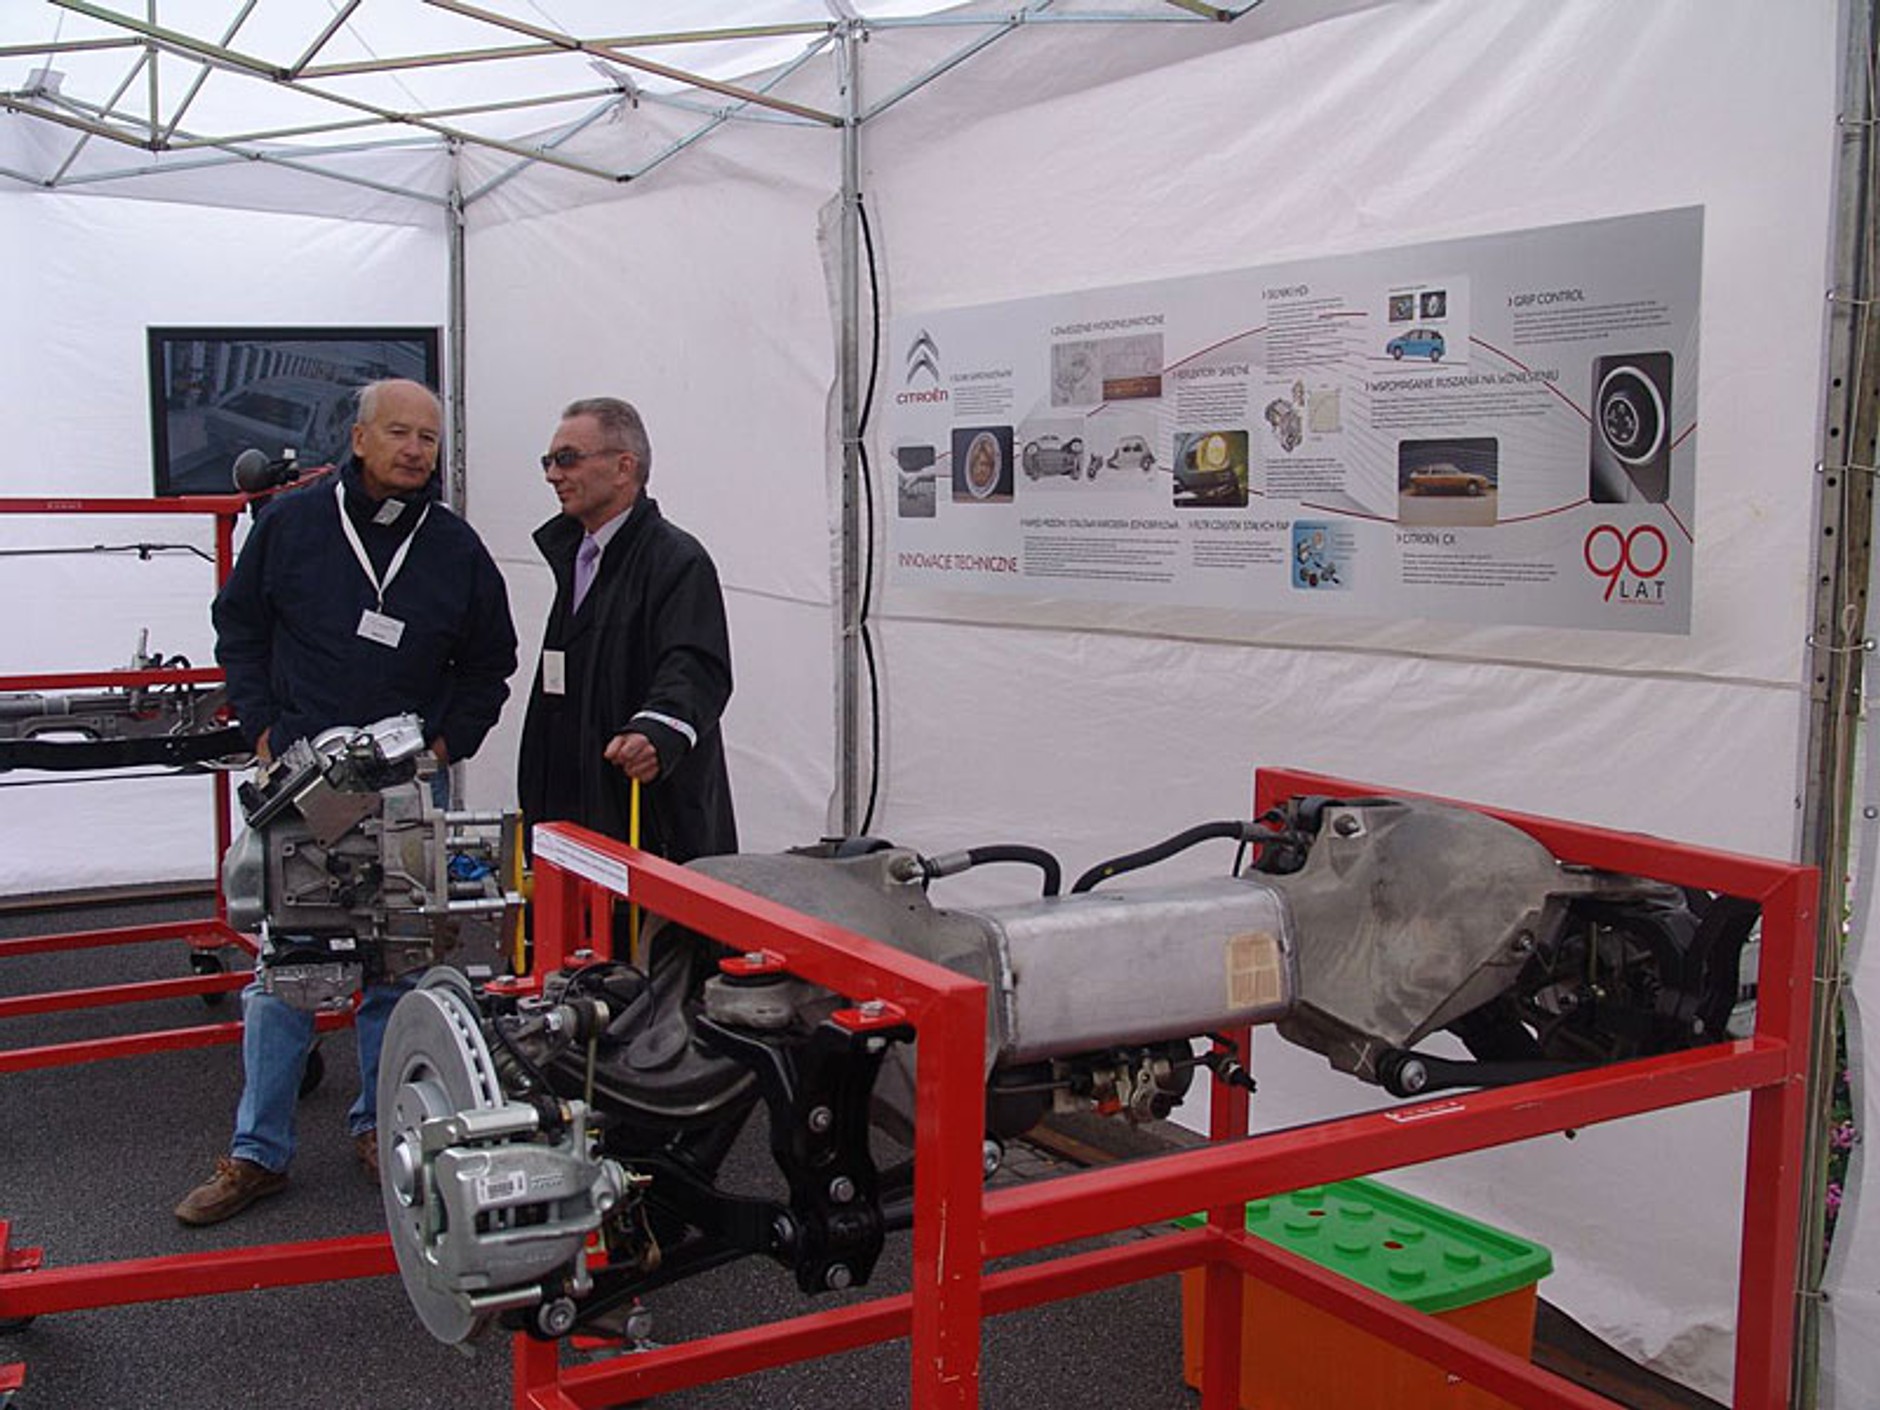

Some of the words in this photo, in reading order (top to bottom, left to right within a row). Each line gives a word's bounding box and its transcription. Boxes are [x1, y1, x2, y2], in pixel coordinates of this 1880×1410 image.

[1537, 289, 1584, 305] CONTROL
[954, 553, 1018, 573] TECHNICZNE
[1584, 524, 1668, 602] 90
[1619, 580, 1665, 599] LAT
